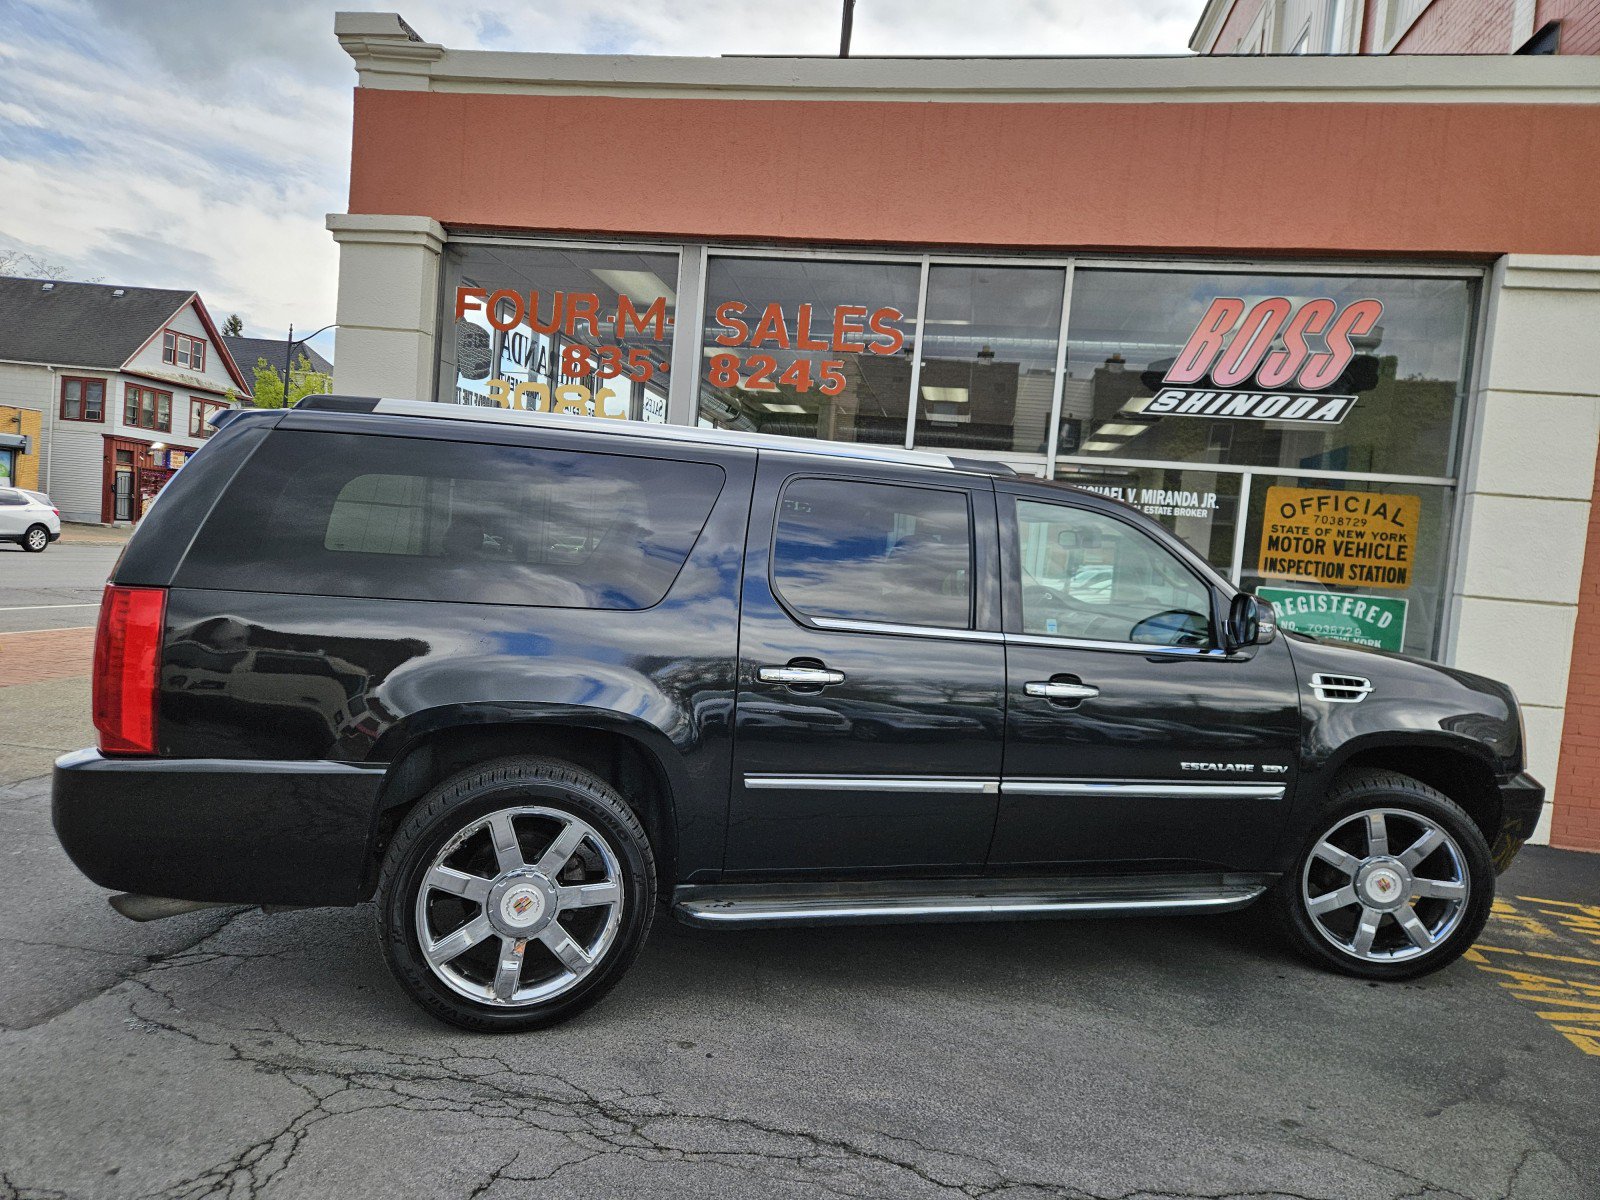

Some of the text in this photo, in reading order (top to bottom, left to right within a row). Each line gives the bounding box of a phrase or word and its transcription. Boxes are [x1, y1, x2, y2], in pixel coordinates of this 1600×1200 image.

[715, 301, 904, 355] SALES
[1162, 297, 1384, 390] BOSS
[708, 353, 847, 396] 8245
[1149, 391, 1348, 421] SHINODA
[1127, 488, 1138, 503] V.
[1141, 489, 1199, 507] MIRANDA
[1201, 492, 1219, 509] JR.
[1144, 505, 1173, 516] ESTATE
[1174, 507, 1208, 518] BROKER
[1280, 495, 1405, 527] OFFICIAL
[1271, 524, 1407, 542] STATE OF NEW YORK
[1313, 515, 1367, 527] 7038729
[1267, 535, 1408, 561] MOTOR VEHICLE
[1264, 557, 1407, 584] INSPECTION STATION
[1270, 594, 1393, 629] REGISTERED
[1280, 620, 1299, 631] NO.
[1180, 761, 1288, 774] ESCALADE ESV
